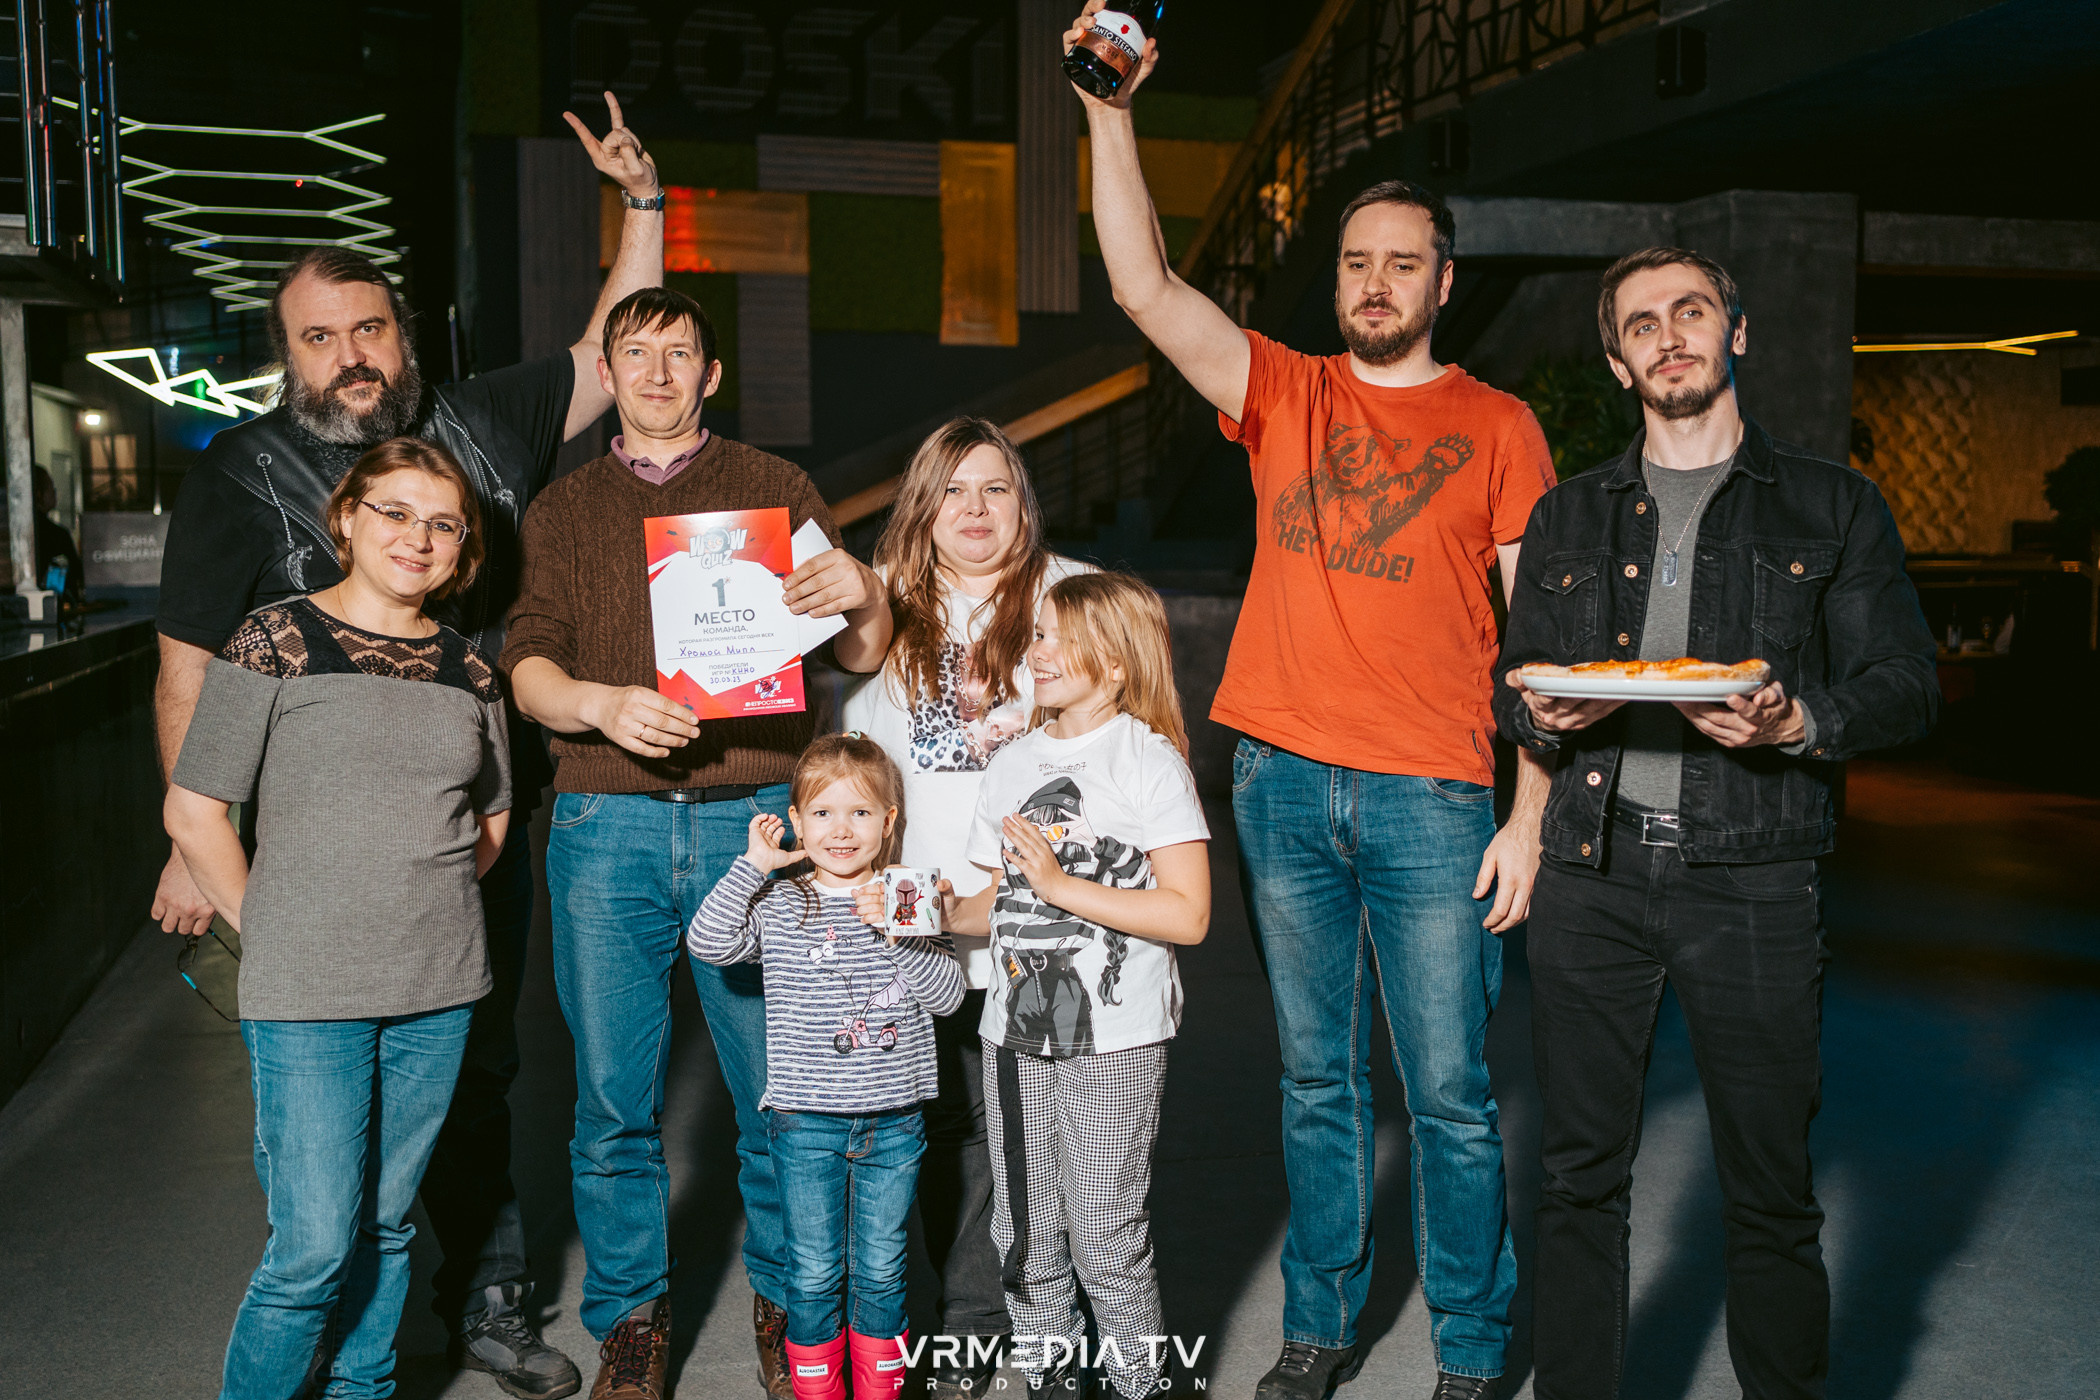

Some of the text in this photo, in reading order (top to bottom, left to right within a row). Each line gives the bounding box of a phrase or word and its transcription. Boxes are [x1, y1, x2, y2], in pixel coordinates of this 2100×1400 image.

[1091, 25, 1138, 61] SANTO STEFANO
[701, 550, 733, 570] QUIZ
[1326, 543, 1415, 583] DUDE!
[711, 578, 726, 607] 1
[694, 608, 756, 626] МЕСТО
[708, 662, 749, 670] ПОБЕДИТЕЛИ
